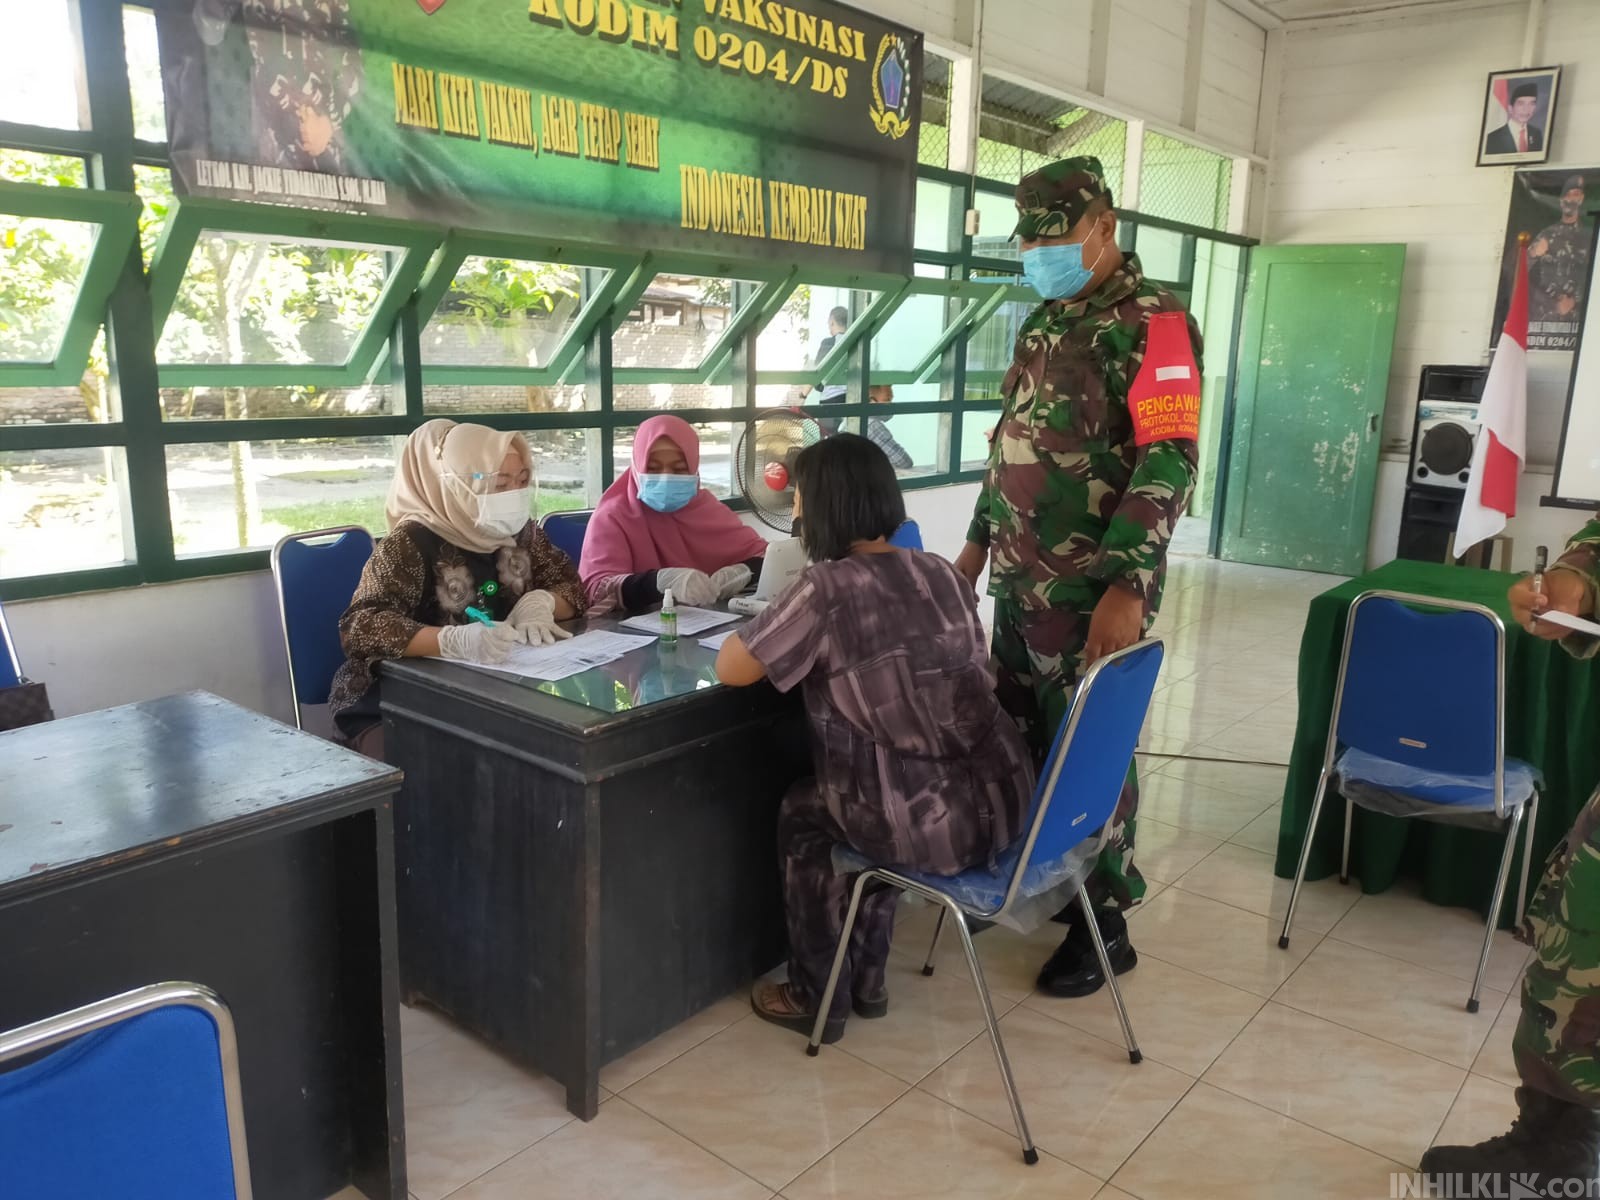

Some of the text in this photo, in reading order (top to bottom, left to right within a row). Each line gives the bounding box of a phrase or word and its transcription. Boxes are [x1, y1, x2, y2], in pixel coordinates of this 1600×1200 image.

[693, 26, 848, 98] 0204/DS
[392, 62, 660, 168] MARI KITA VAKSIN, AGAR TETAP SEHAT
[680, 164, 868, 250] INDONESIA KEMBALI KUAT
[1137, 394, 1200, 418] PENGAWA
[1140, 412, 1180, 429] PROTOKOL
